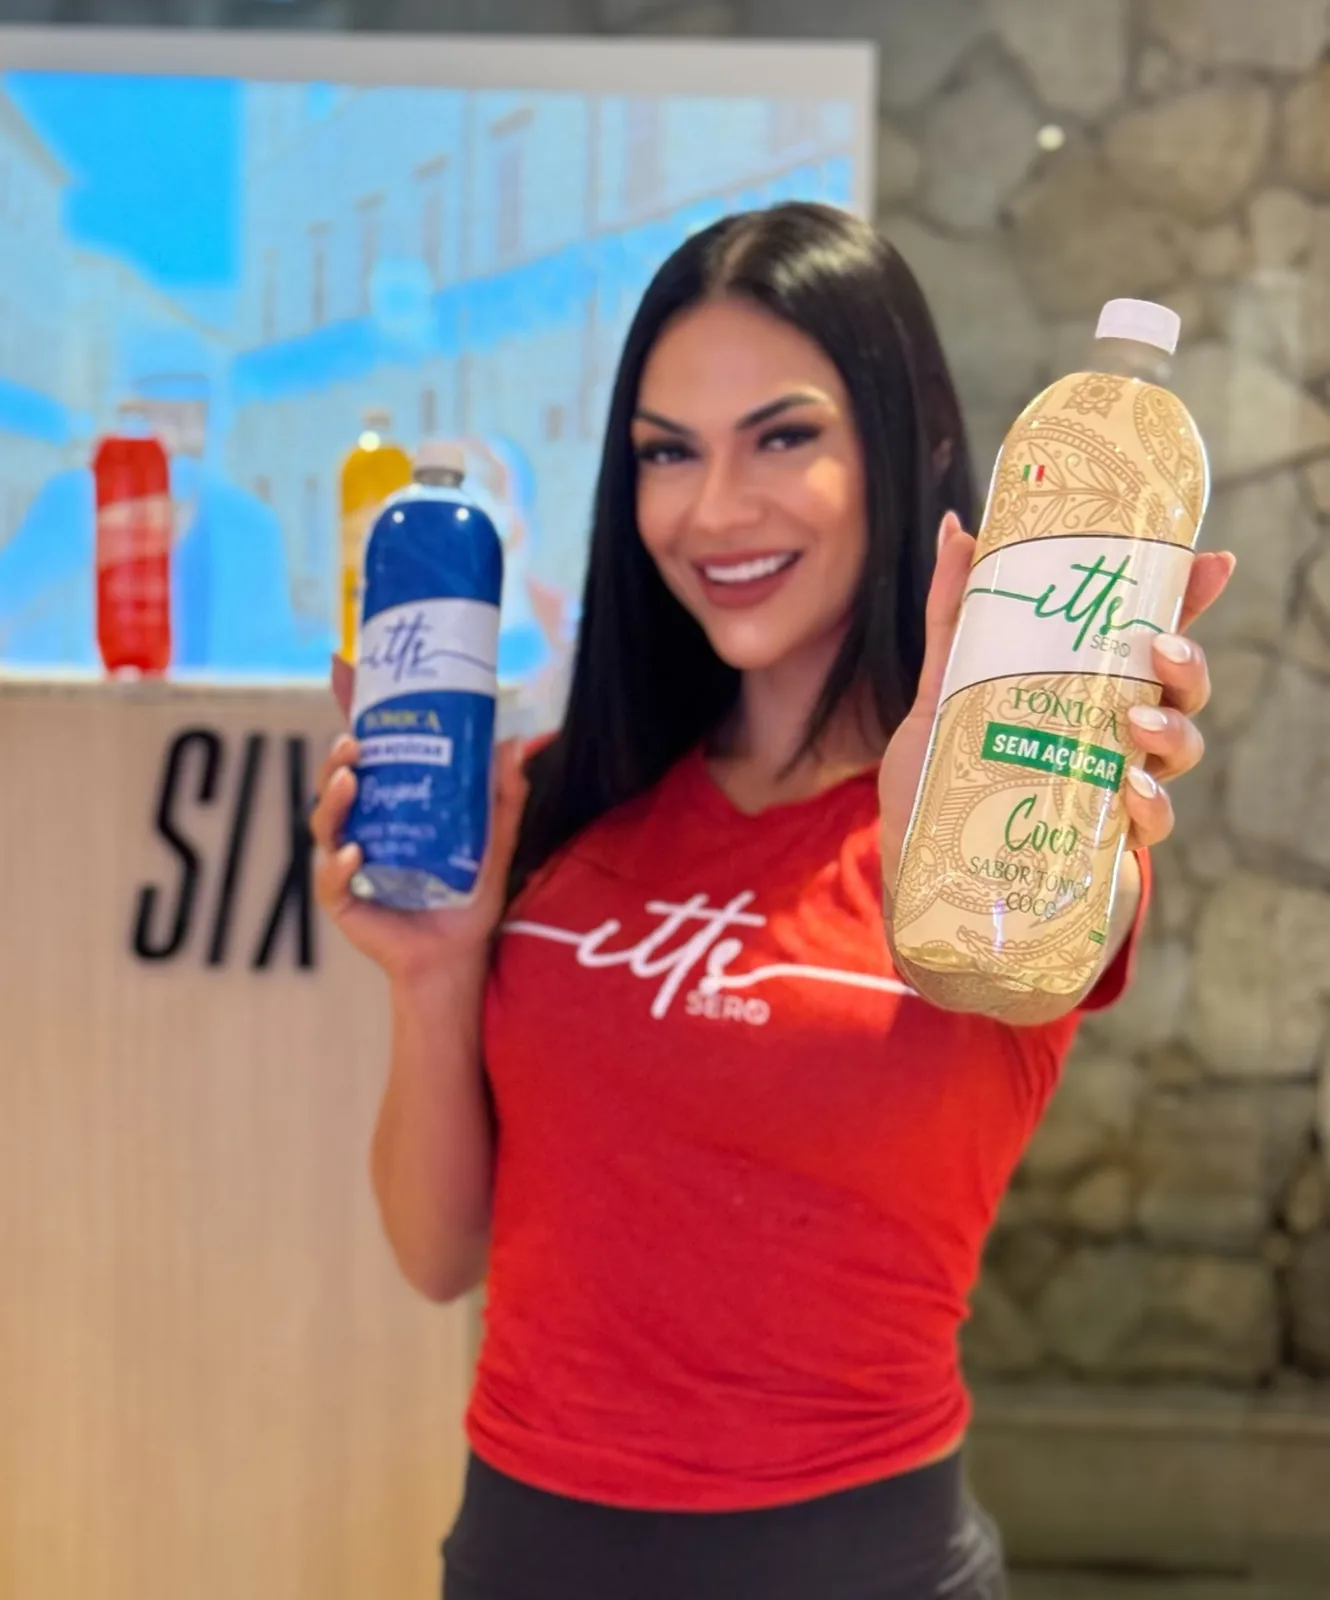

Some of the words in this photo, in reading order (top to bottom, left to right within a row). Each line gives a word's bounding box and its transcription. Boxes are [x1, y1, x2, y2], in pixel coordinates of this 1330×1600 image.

[1090, 634, 1131, 658] SERO
[1007, 687, 1120, 743] TÔNICA
[992, 734, 1040, 759] SEM
[1041, 744, 1118, 782] AÇÚCAR
[133, 729, 317, 967] SIX
[1004, 794, 1077, 856] Coco
[968, 857, 1031, 886] SABOR
[1006, 892, 1057, 919] COCO
